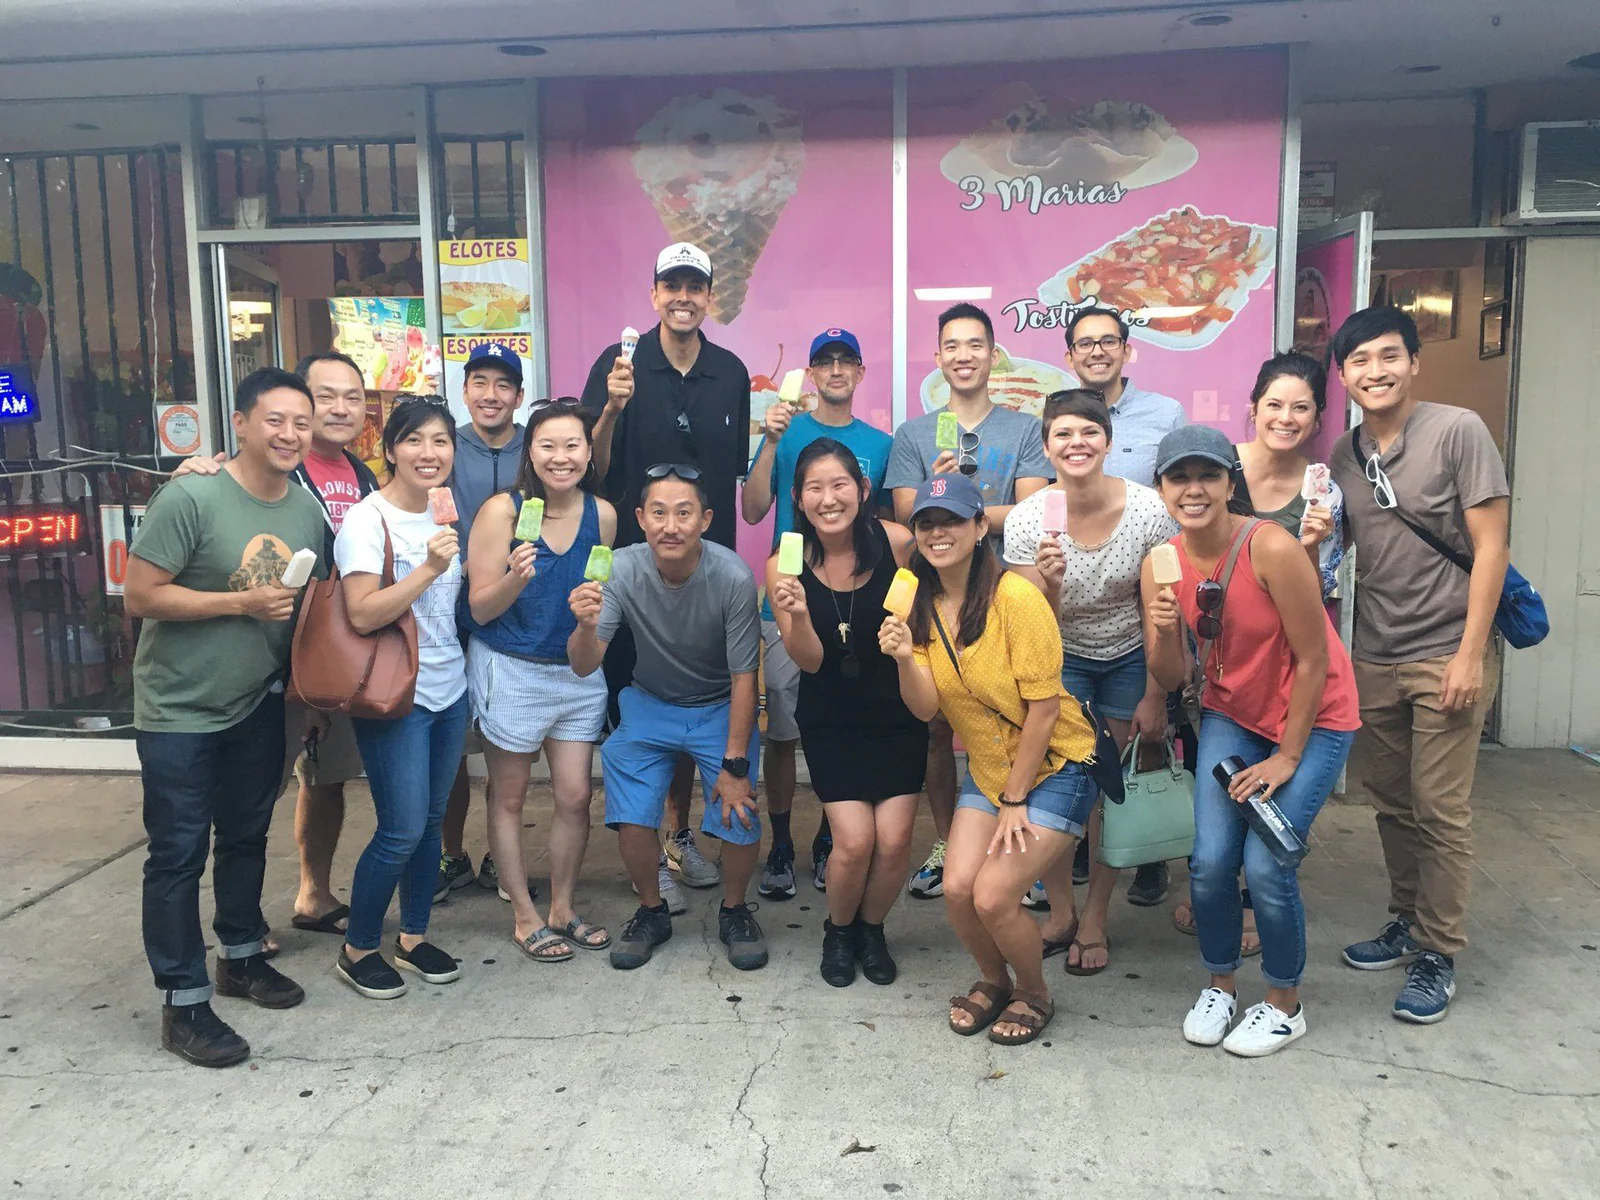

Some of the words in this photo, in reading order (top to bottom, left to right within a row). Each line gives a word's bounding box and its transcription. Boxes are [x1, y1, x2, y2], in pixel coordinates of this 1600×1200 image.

[959, 175, 984, 211] 3
[995, 174, 1128, 214] Marias
[450, 241, 517, 258] ELOTES
[930, 477, 947, 497] B
